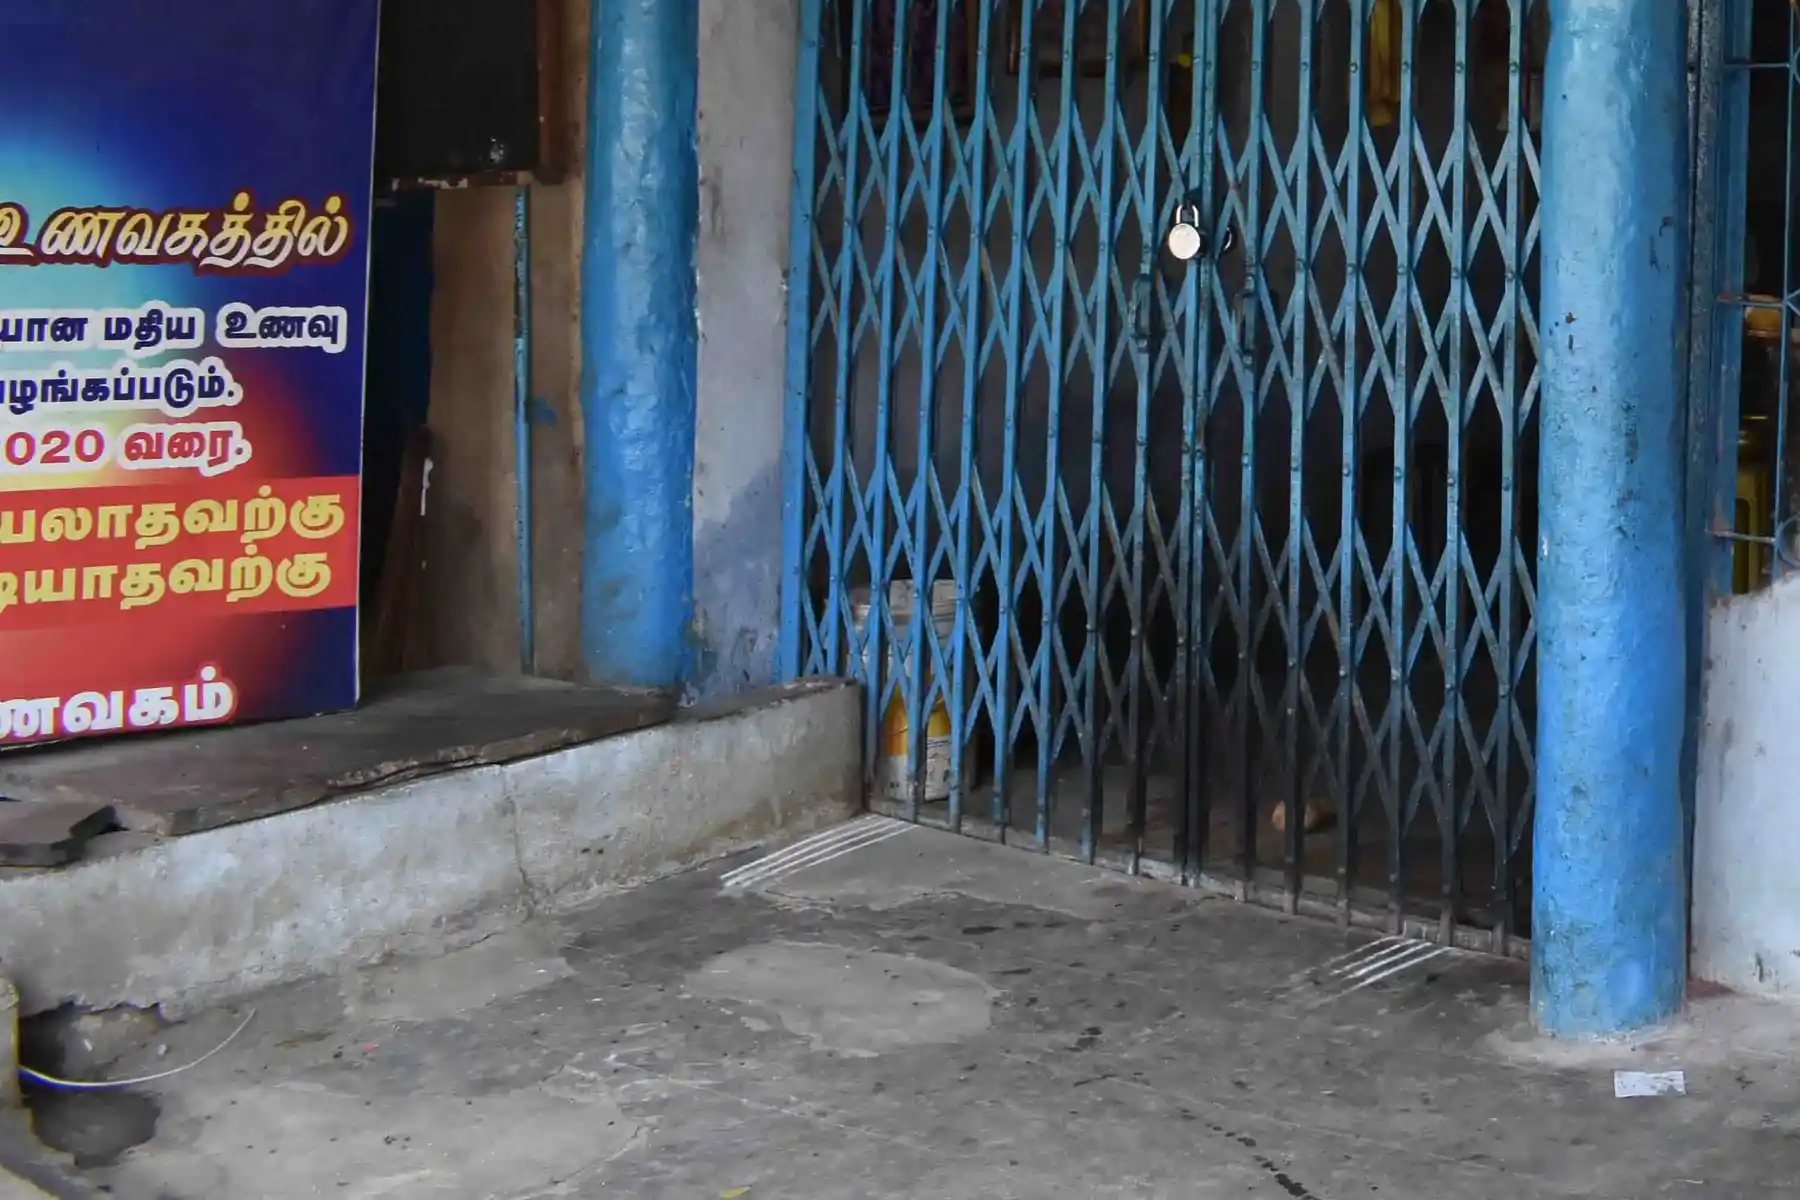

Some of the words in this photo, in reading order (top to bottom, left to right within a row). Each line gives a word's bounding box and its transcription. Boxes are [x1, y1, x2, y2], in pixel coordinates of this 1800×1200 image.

[105, 308, 197, 350] மதிய
[225, 310, 338, 344] உணவு
[0, 364, 235, 416] ழங்கப்படும்.
[124, 429, 243, 466] வரை.
